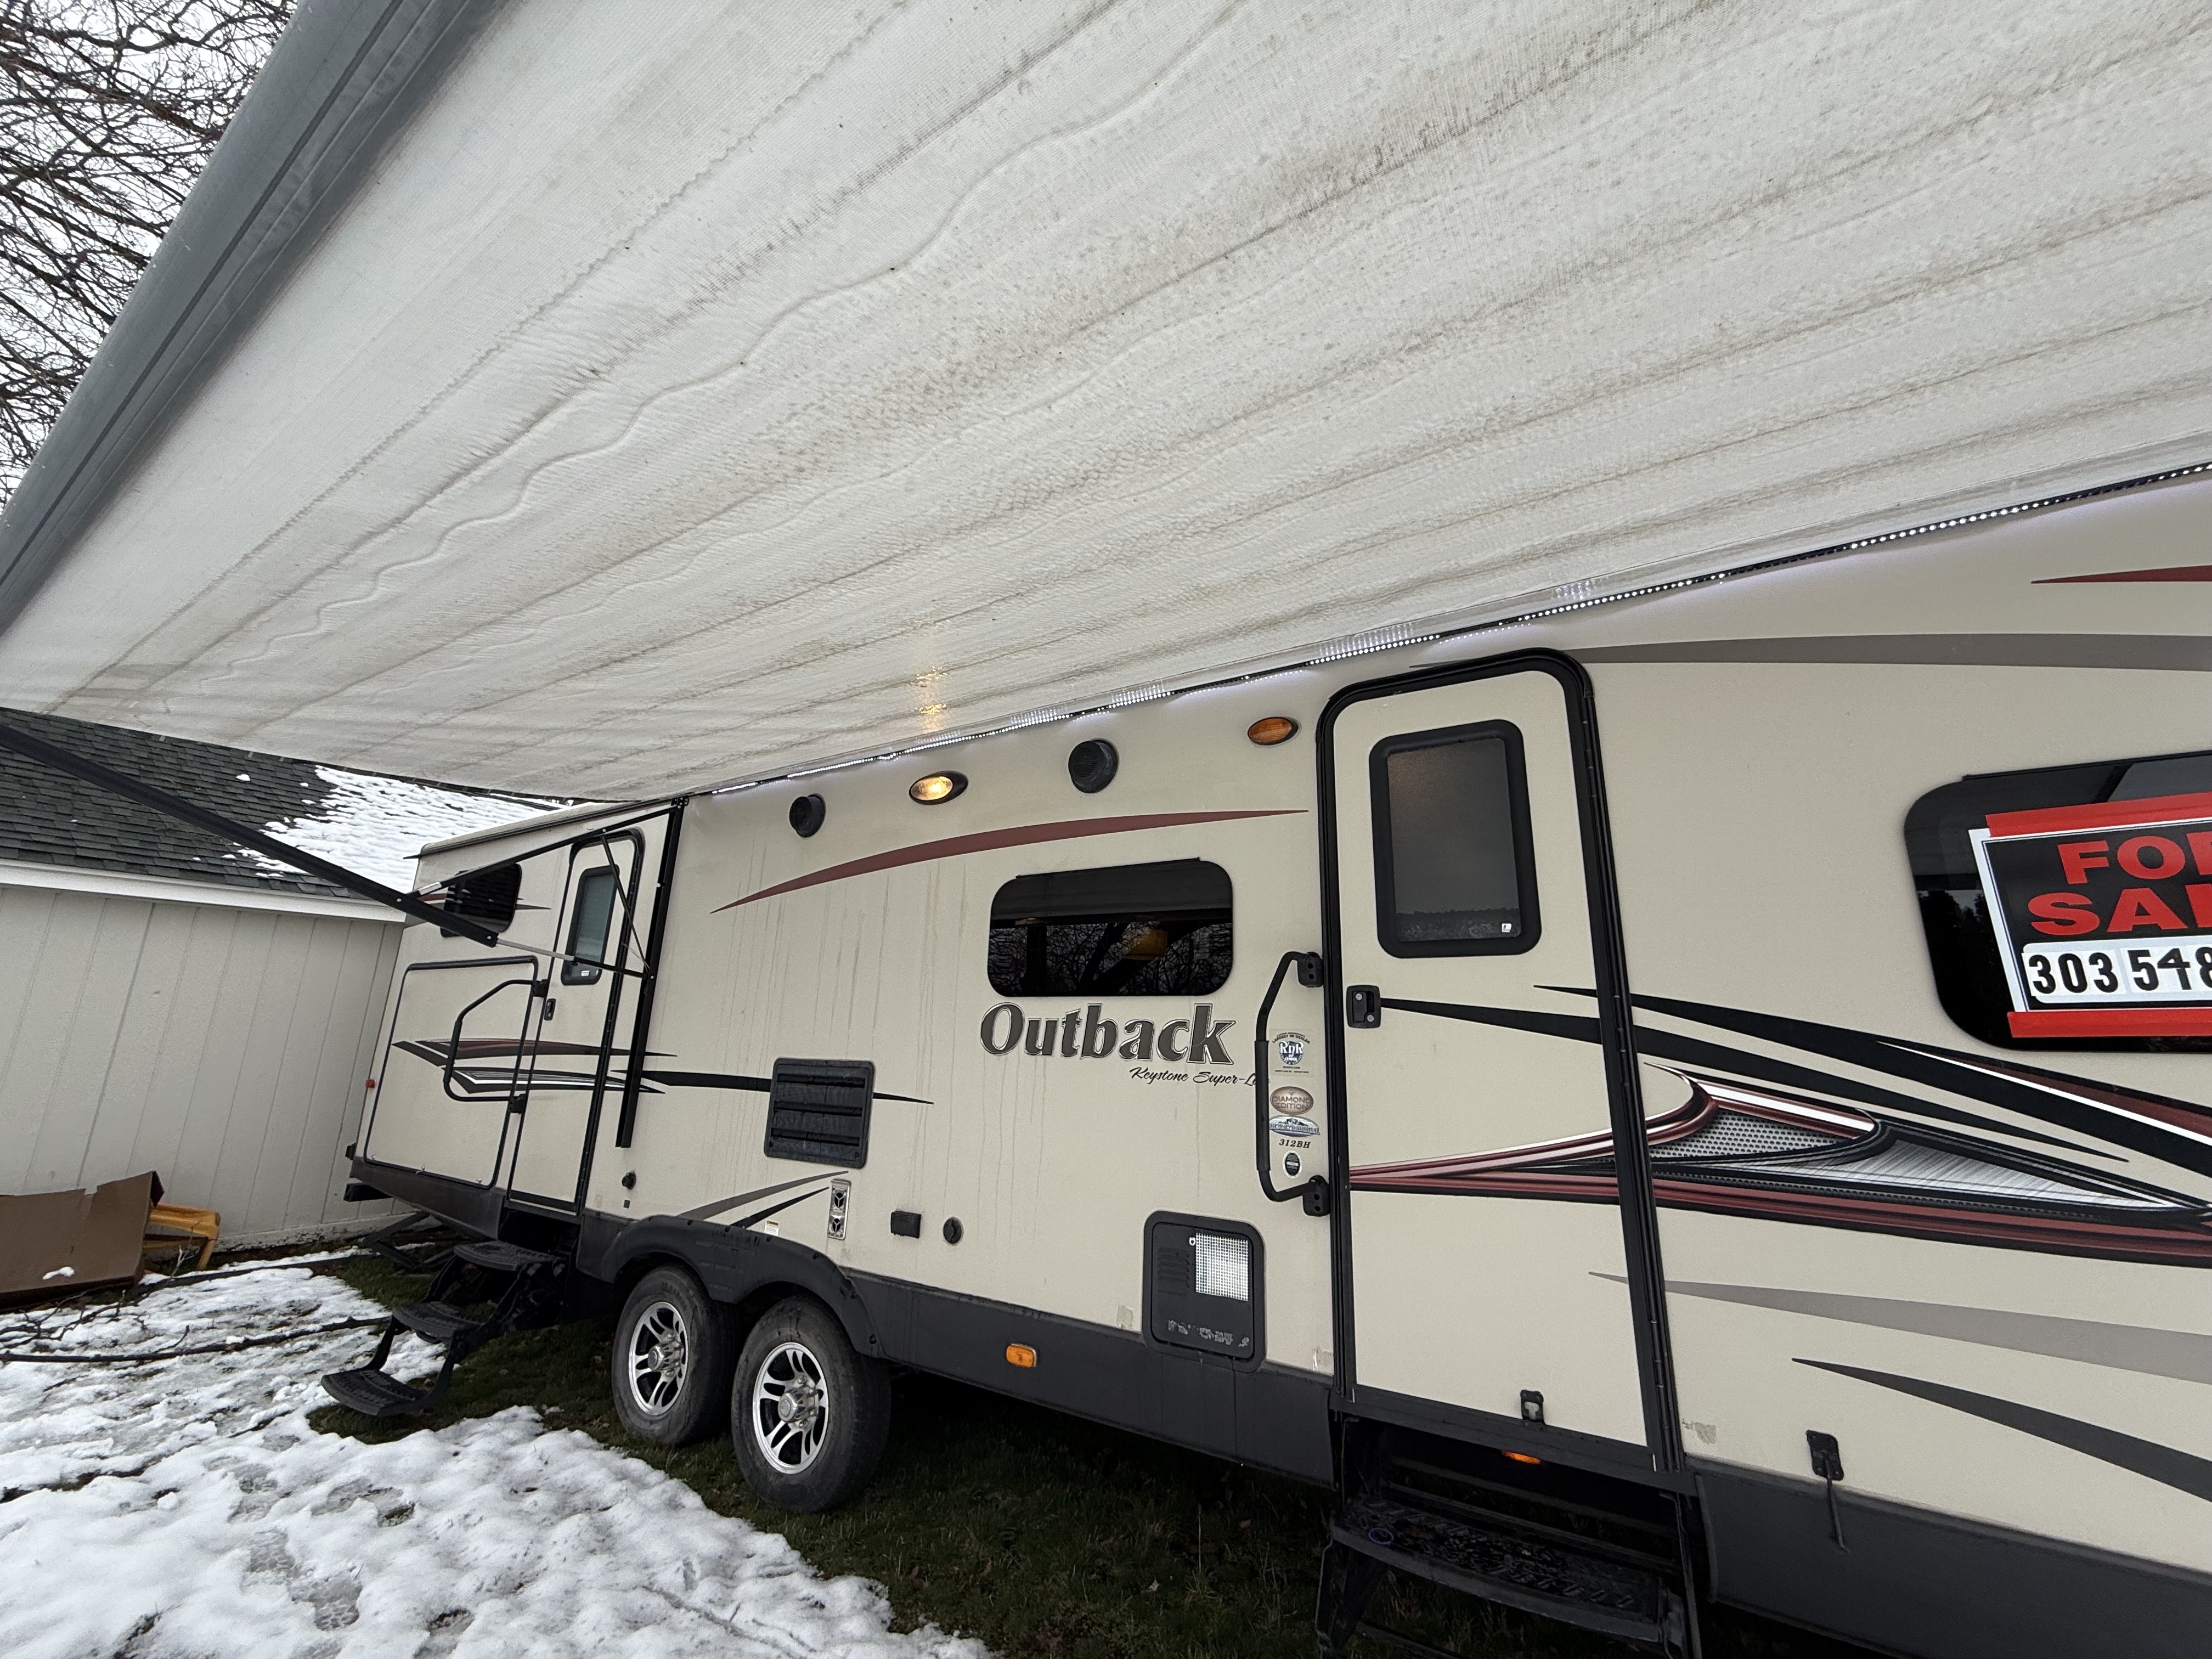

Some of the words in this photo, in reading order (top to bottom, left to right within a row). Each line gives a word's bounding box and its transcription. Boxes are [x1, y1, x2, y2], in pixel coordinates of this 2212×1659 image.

[2029, 952, 2119, 994] 303
[980, 1002, 1236, 1065] Outback
[1129, 1066, 1189, 1085] Keystone
[1279, 1138, 1311, 1149] 312BH
